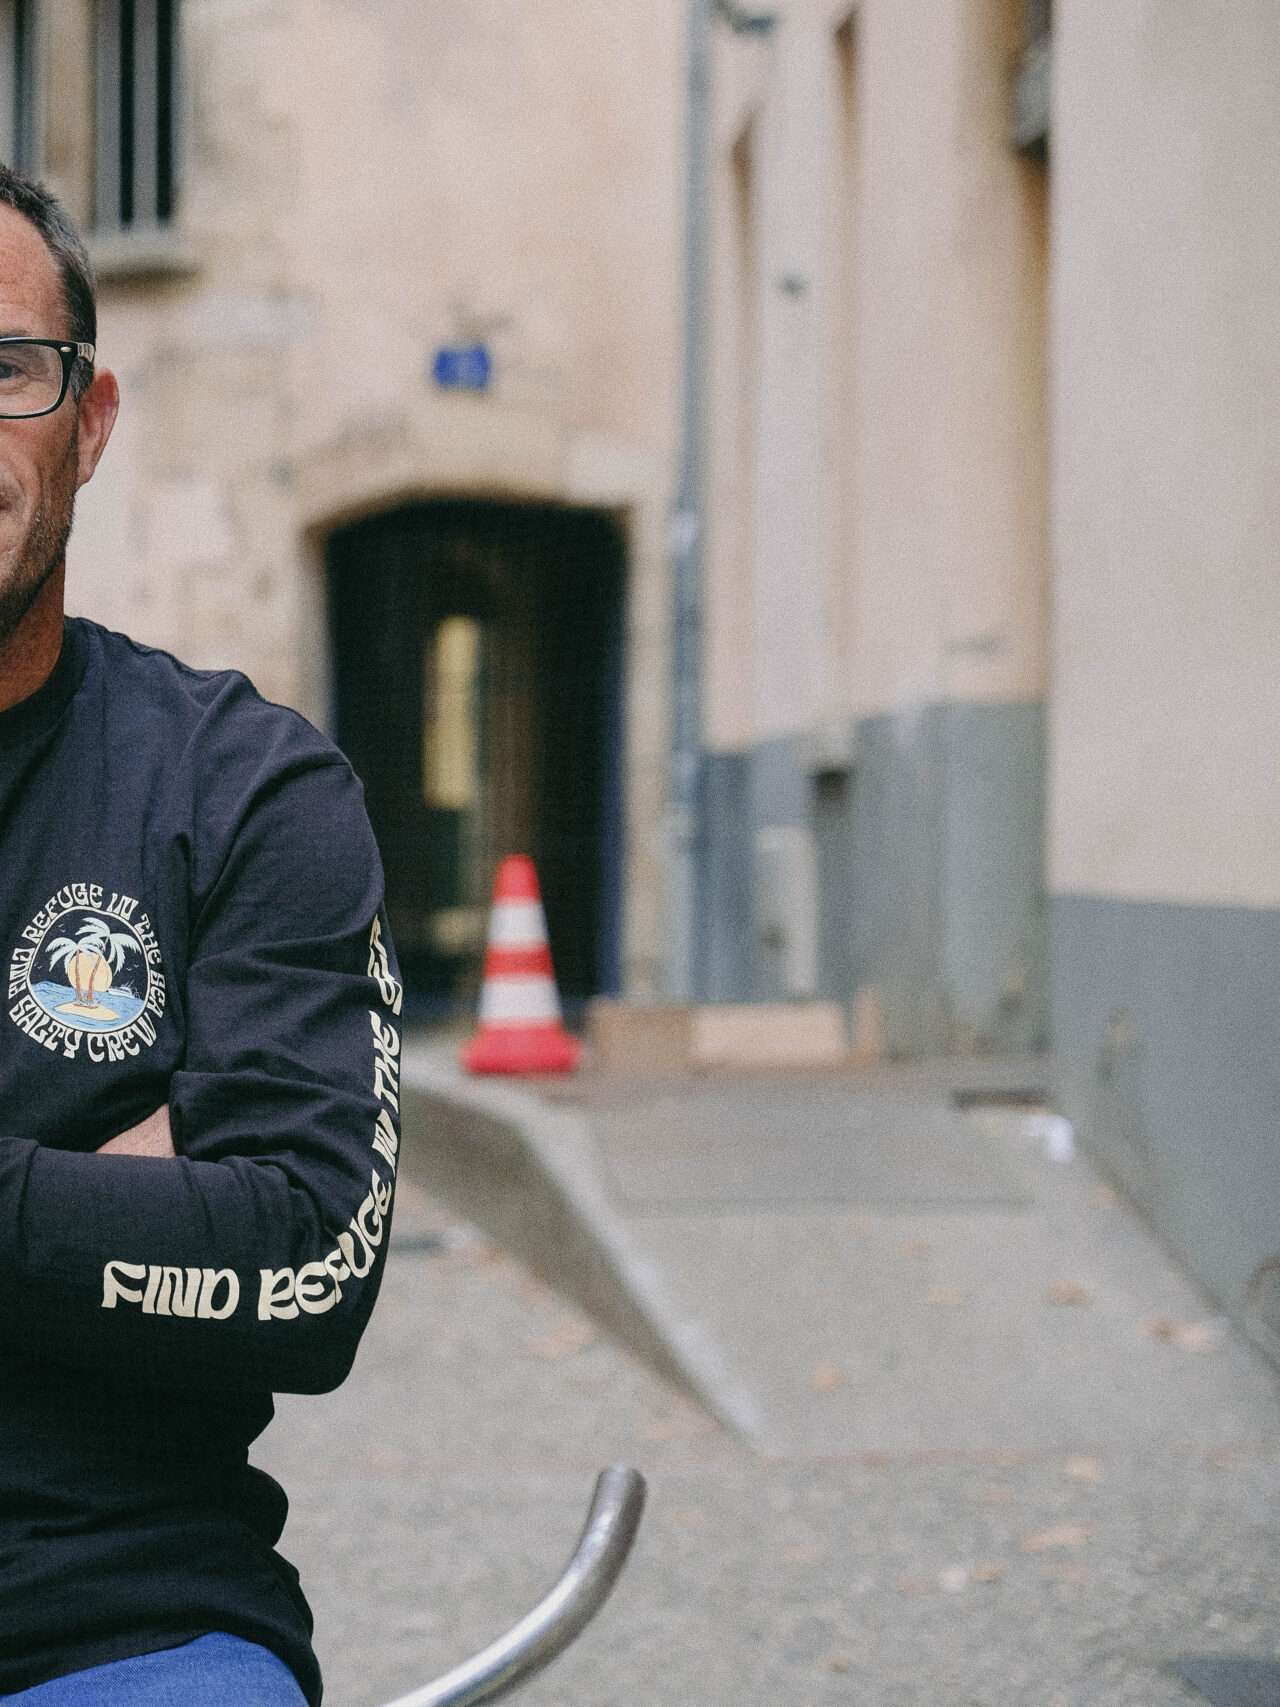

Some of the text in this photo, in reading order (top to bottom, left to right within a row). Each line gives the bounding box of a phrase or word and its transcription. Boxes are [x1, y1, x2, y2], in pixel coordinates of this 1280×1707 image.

[8, 883, 166, 1018] FIND REFUGE IN THE SEA
[8, 994, 157, 1063] SALTY CREW
[369, 1010, 400, 1114] THE
[371, 1108, 398, 1179] IN
[257, 1168, 393, 1321] REFUGE
[101, 1260, 240, 1321] FIND
